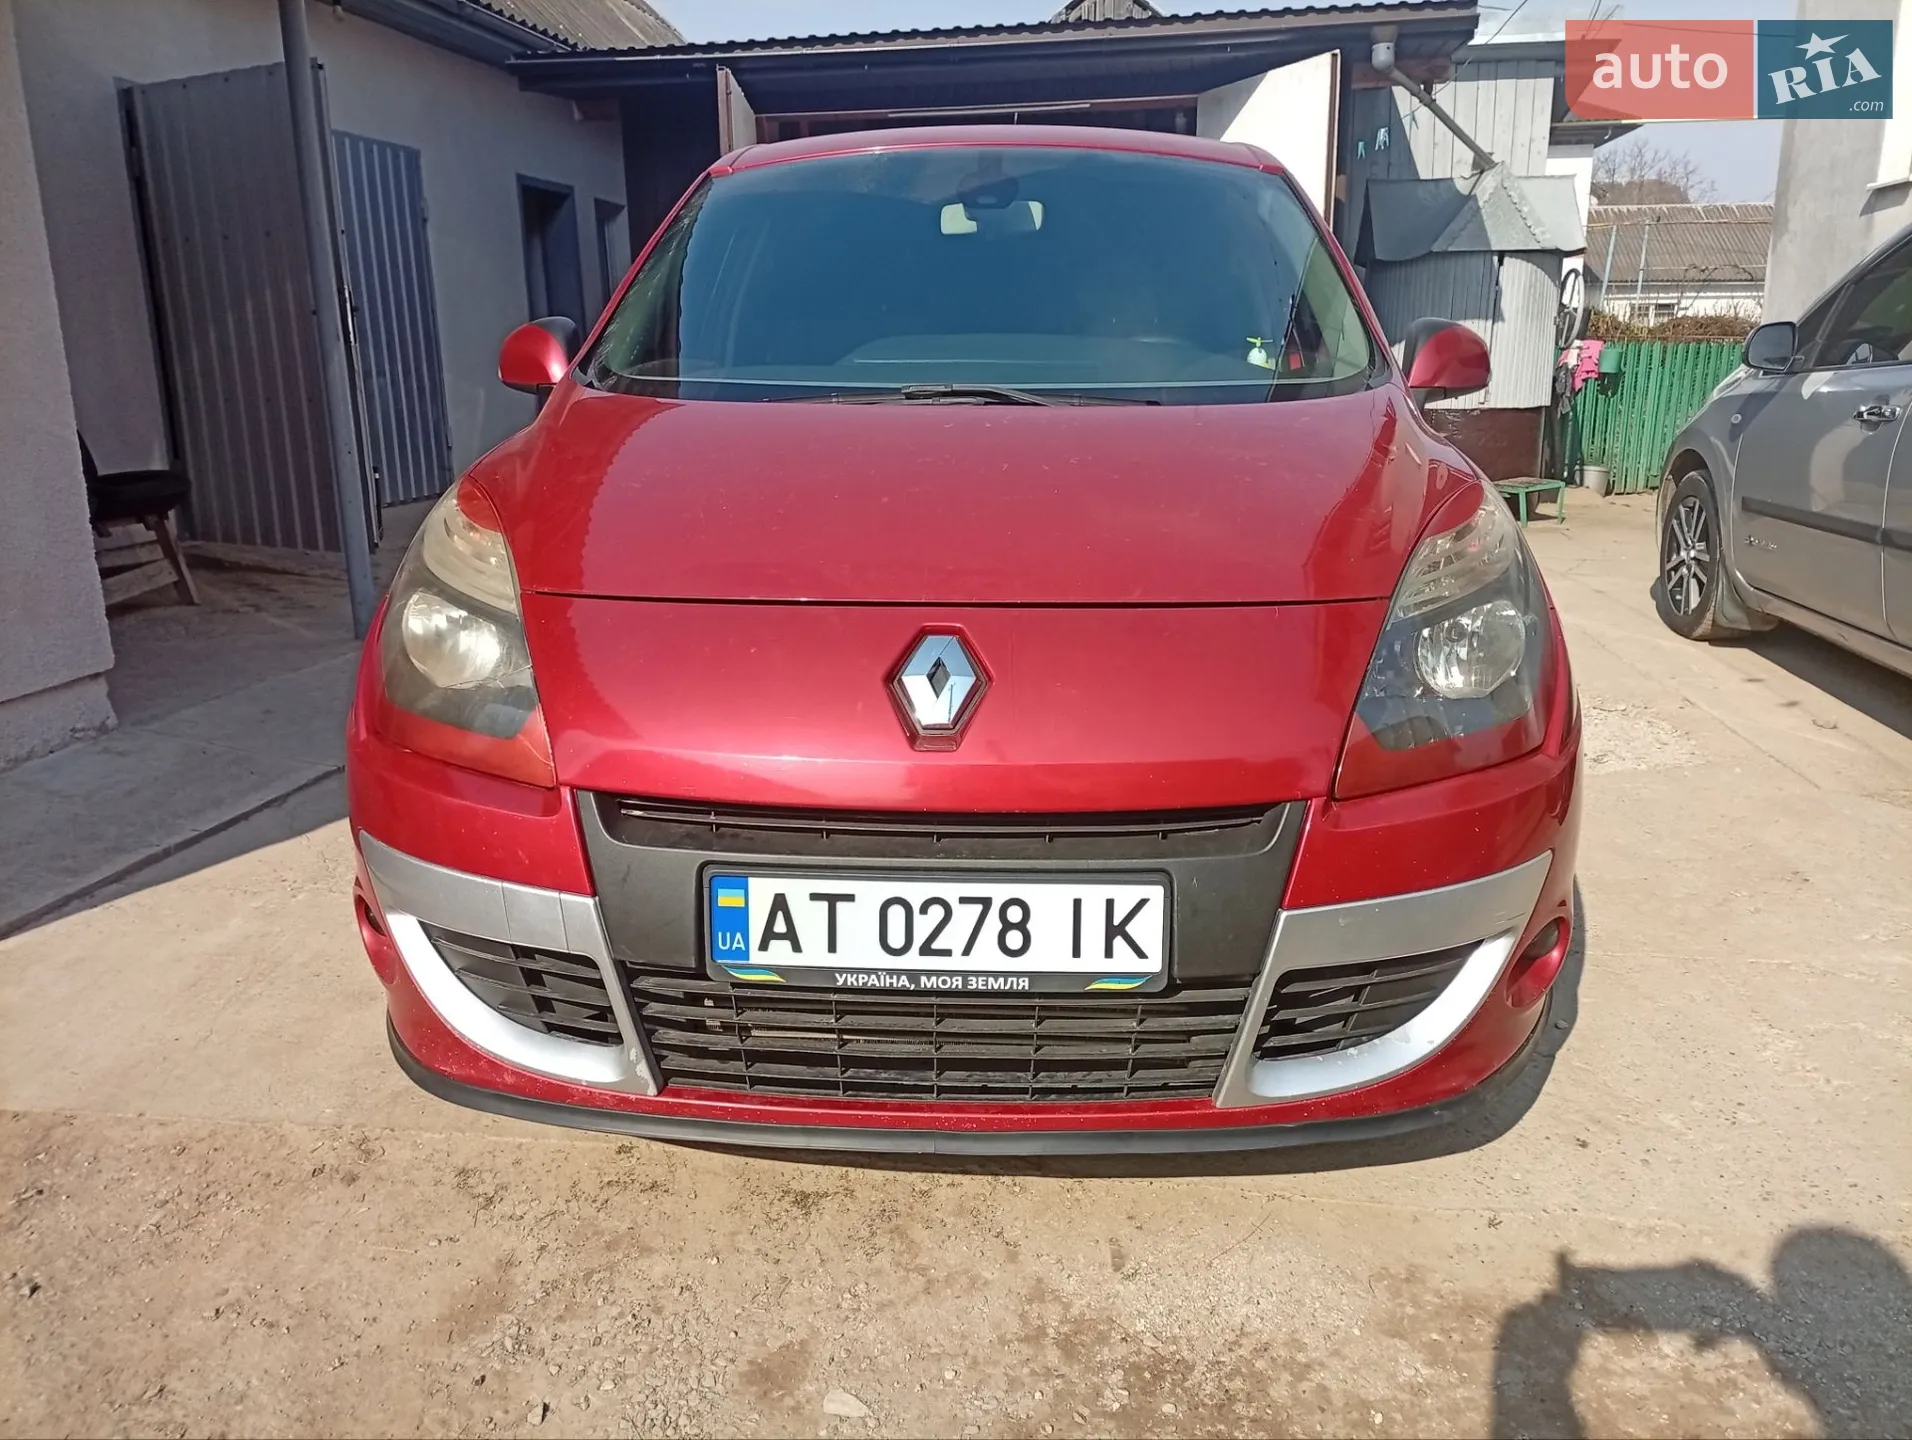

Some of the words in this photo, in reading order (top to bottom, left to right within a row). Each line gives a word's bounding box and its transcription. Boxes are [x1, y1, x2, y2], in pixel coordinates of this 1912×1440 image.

[757, 892, 856, 954] AT
[878, 896, 1032, 958] 0278
[1071, 897, 1151, 960] IK
[717, 931, 746, 951] UA
[834, 972, 915, 991] УКРАЇНА,
[920, 975, 963, 990] МОЯ
[967, 976, 1030, 991] ЗЕМЛЯ
